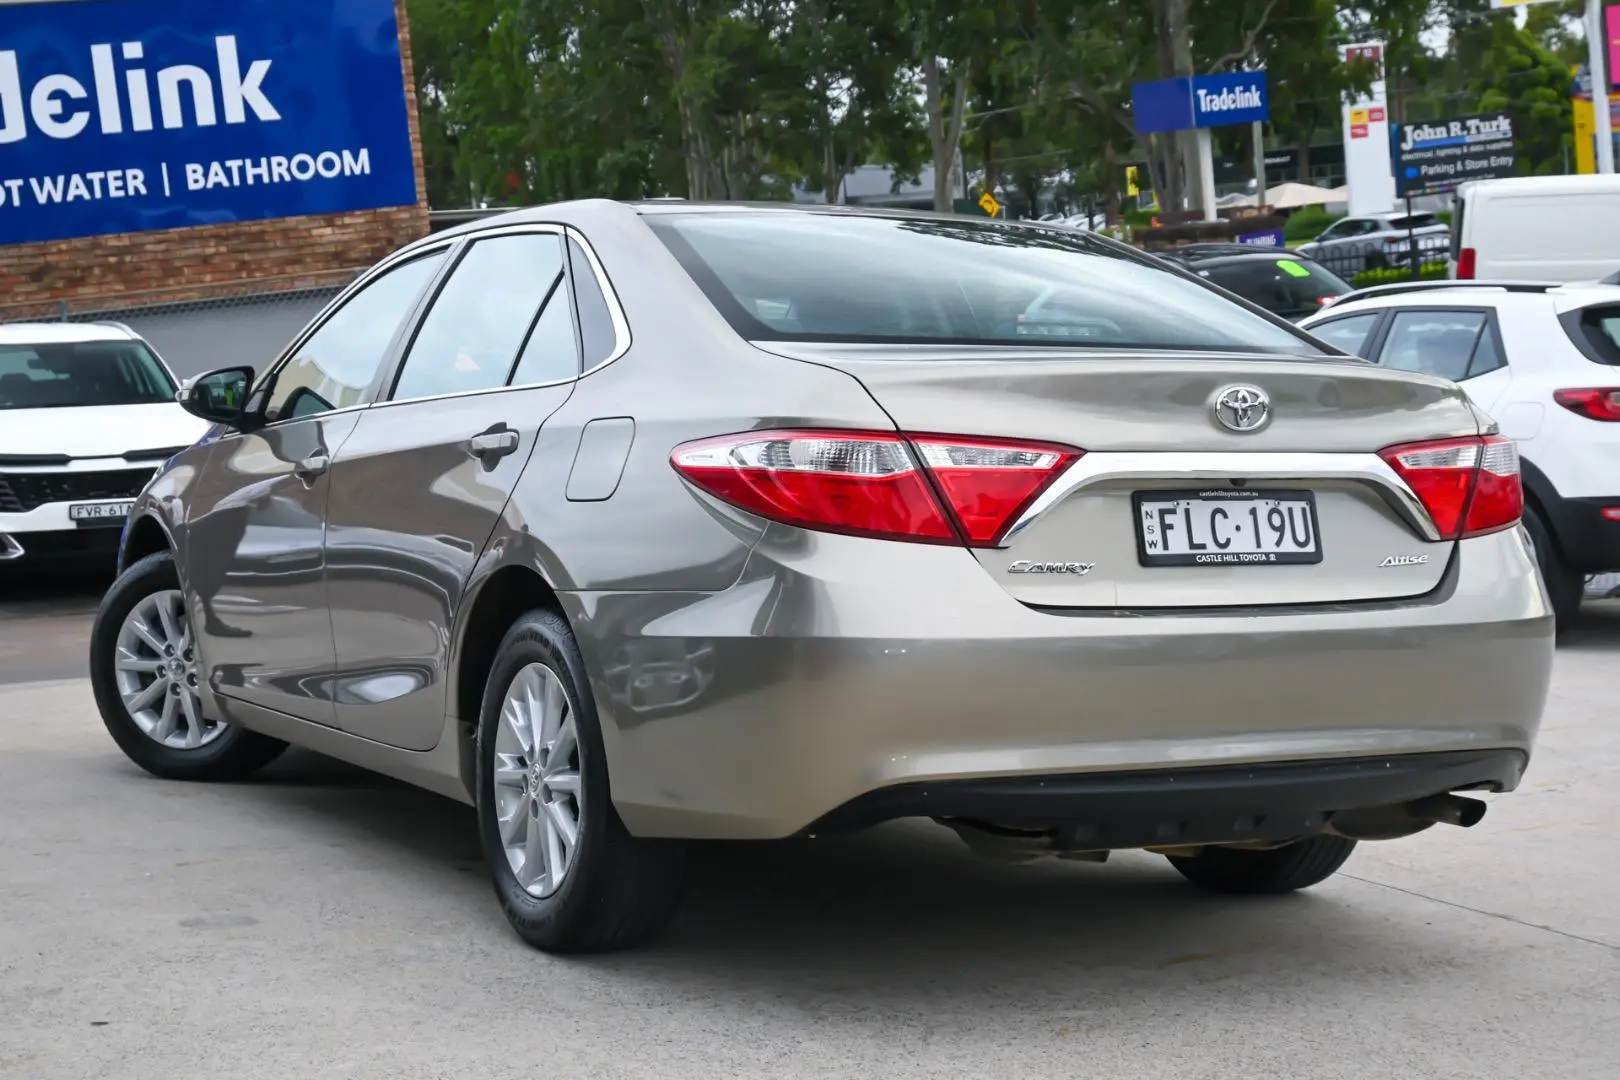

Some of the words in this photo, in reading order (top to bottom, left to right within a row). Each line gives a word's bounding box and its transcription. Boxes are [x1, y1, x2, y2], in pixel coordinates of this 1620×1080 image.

[1197, 84, 1262, 112] Tradelink
[1401, 124, 1448, 151] John
[1466, 115, 1512, 135] Turk
[1421, 162, 1455, 176] Parking
[1456, 160, 1464, 171] &
[1465, 157, 1489, 170] Store
[1490, 155, 1513, 167] Entry
[0, 178, 24, 208] T
[30, 167, 148, 205] WATER
[185, 148, 371, 191] BATHROOM
[1199, 490, 1259, 498] castlehilltoyota.com.au
[1196, 554, 1222, 562] CASTLE
[1223, 554, 1239, 562] HILL
[1240, 553, 1267, 561] TOYOTA
